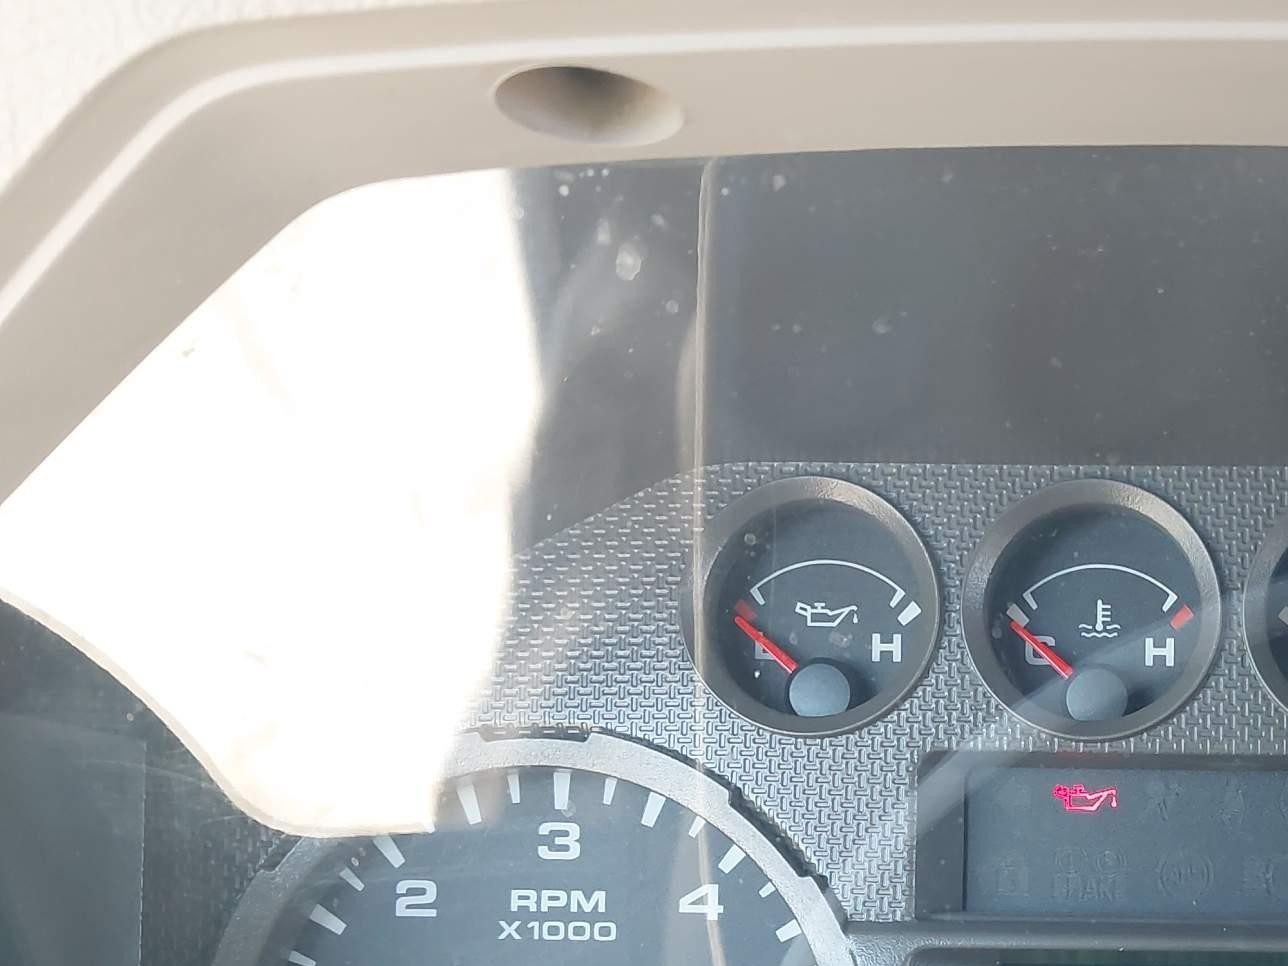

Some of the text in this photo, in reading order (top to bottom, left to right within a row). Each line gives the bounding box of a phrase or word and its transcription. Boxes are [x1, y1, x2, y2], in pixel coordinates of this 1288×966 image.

[872, 633, 902, 662] H
[1024, 636, 1056, 666] C
[1145, 637, 1175, 667] H
[537, 822, 581, 861] 3
[395, 880, 438, 917] 2
[510, 890, 607, 914] RPM
[678, 883, 724, 921] 4
[498, 921, 617, 942] X1000
